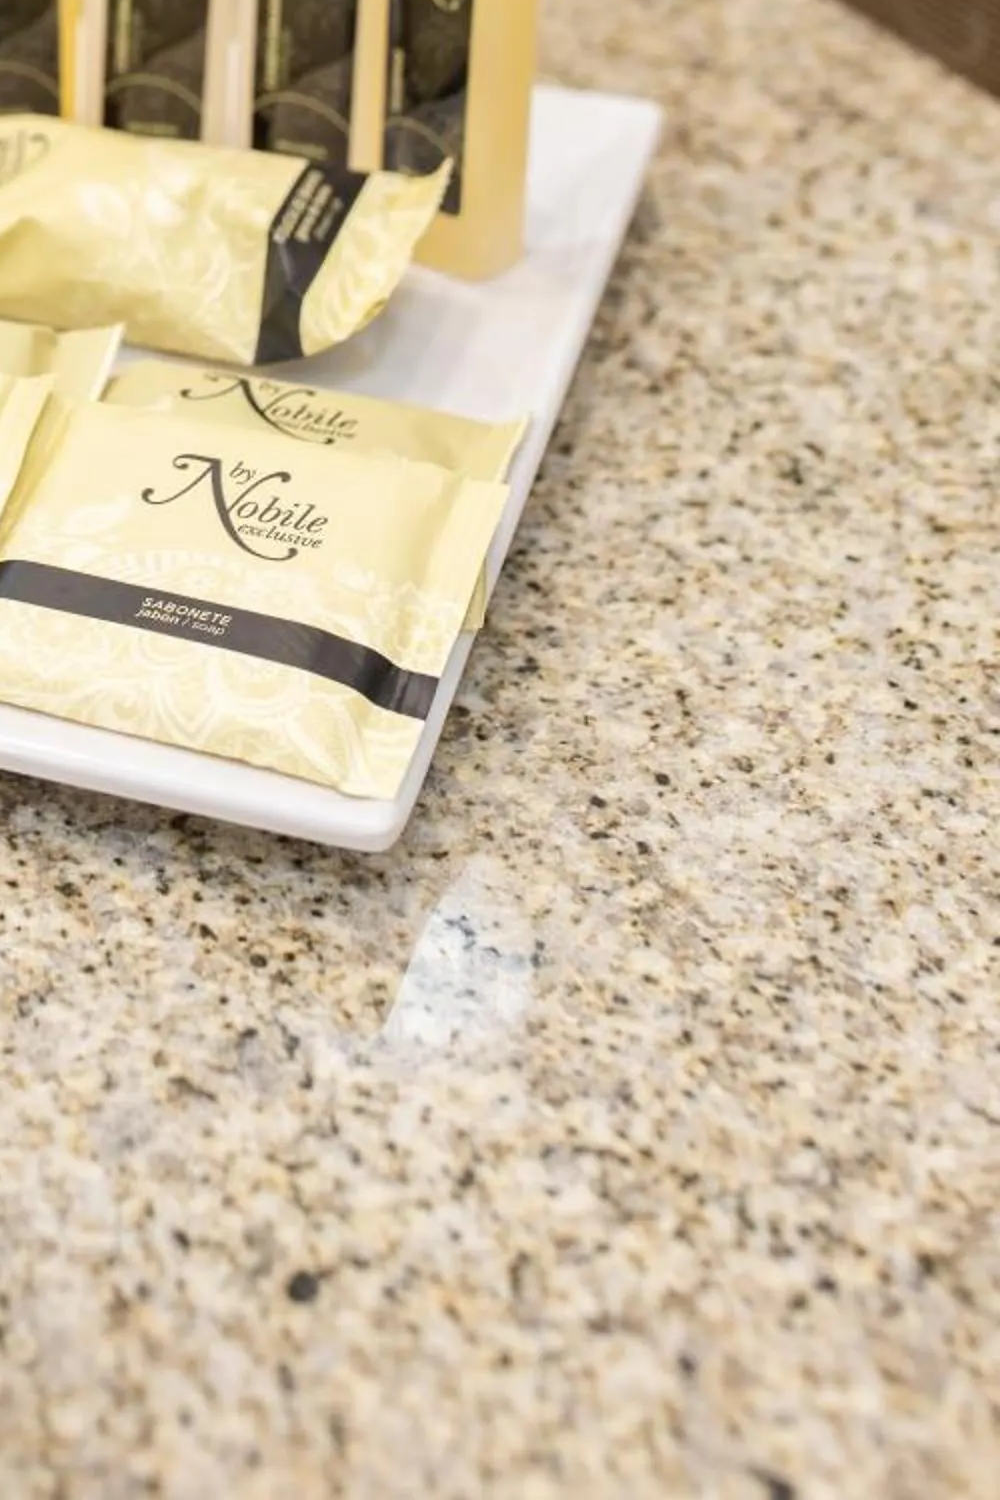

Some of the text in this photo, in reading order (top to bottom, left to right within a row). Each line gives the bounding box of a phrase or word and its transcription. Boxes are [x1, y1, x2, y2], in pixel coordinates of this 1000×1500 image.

[180, 372, 359, 445] Nobile
[229, 460, 257, 485] by
[141, 453, 329, 562] Nobile
[237, 523, 324, 549] exclusive
[142, 597, 233, 627] SABONETE
